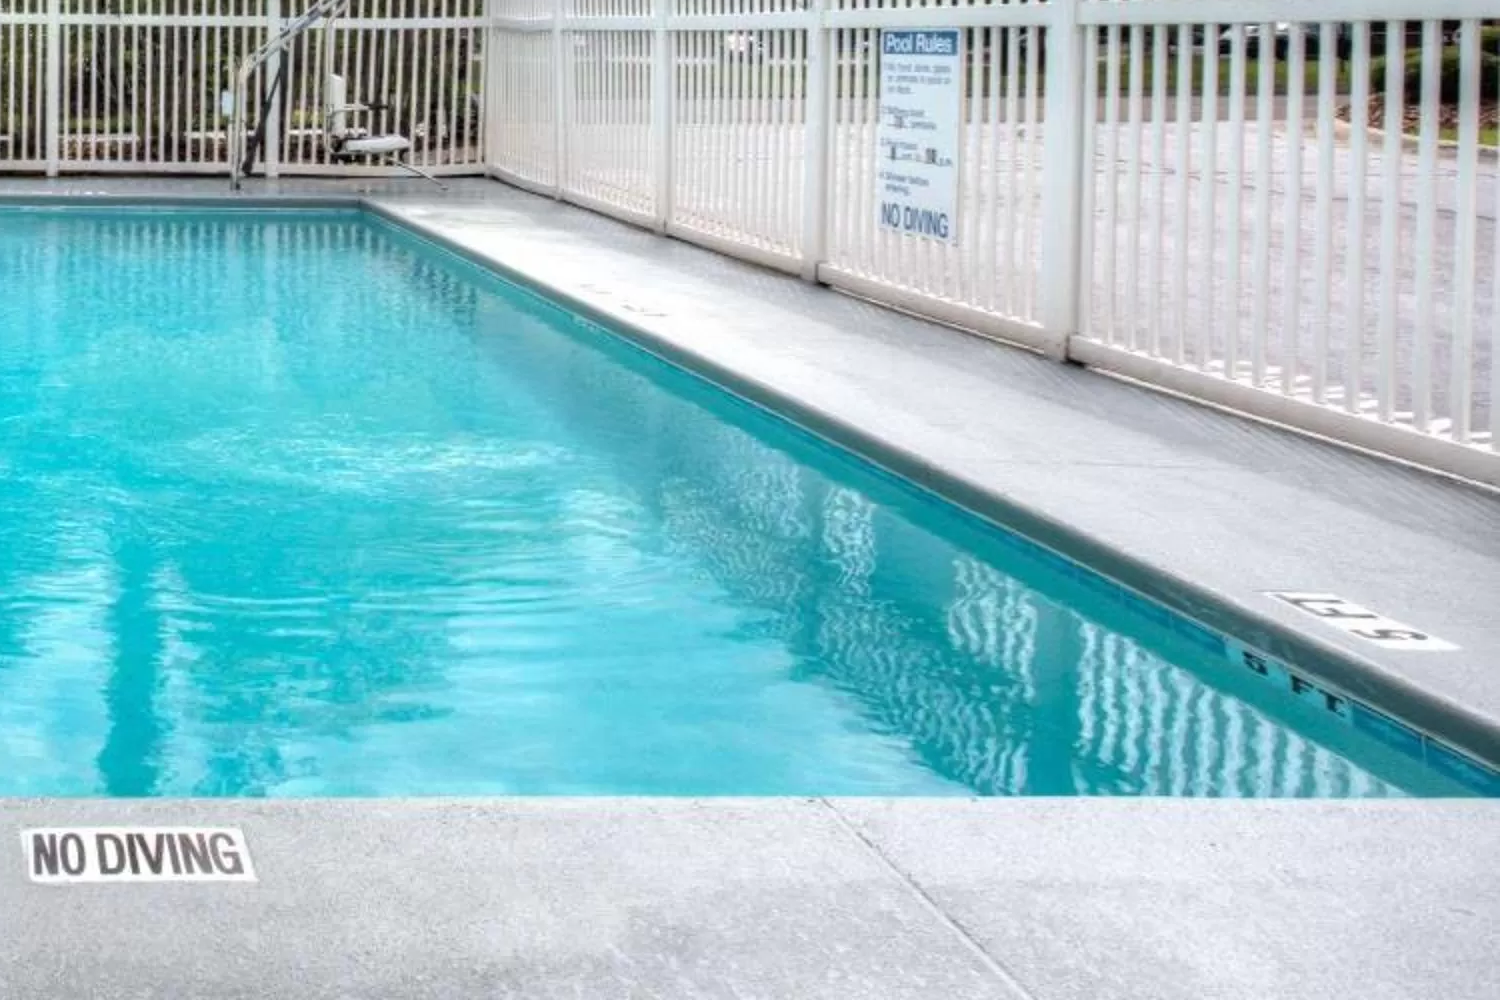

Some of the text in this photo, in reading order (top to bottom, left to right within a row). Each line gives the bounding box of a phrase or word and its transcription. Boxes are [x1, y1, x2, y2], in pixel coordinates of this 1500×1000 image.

[886, 33, 952, 53] Pool Rules
[881, 201, 948, 238] NO DIVING
[1274, 593, 1429, 640] 5 FT
[32, 833, 244, 875] NO DIVING
